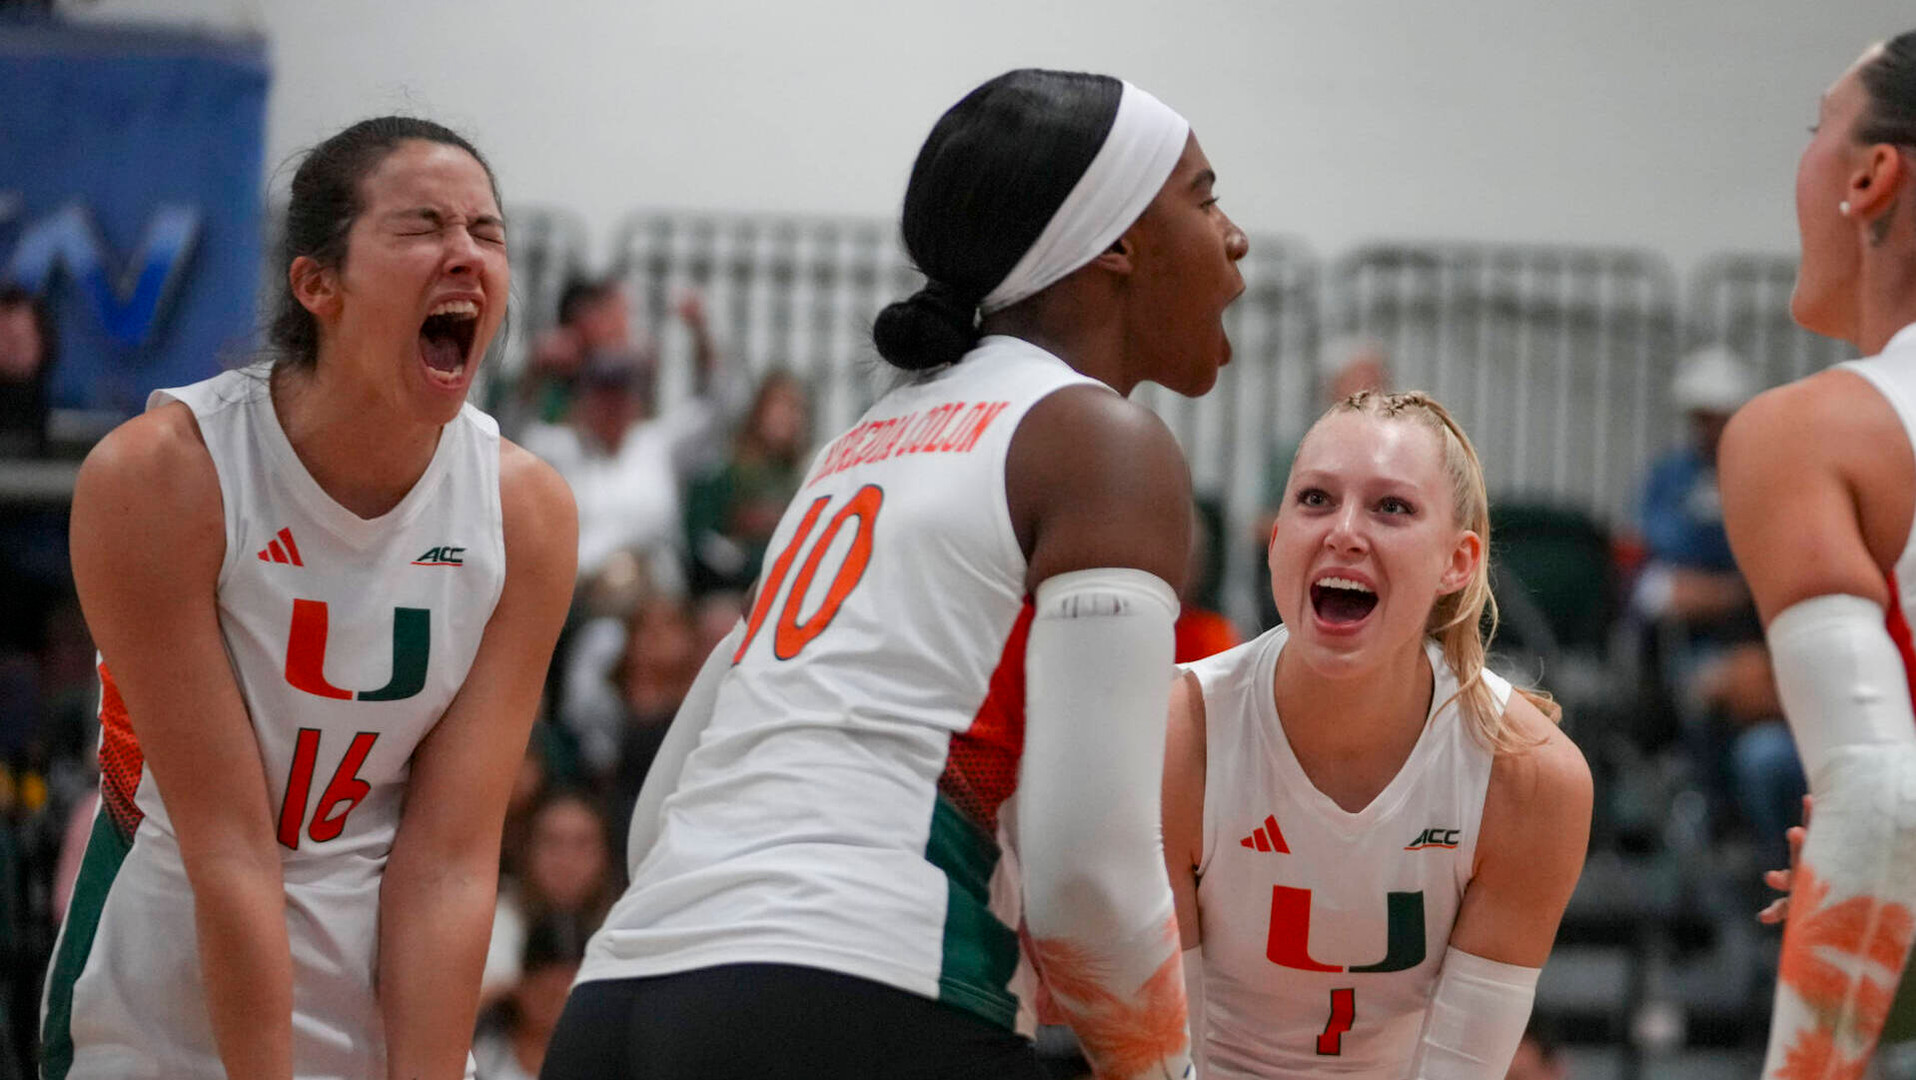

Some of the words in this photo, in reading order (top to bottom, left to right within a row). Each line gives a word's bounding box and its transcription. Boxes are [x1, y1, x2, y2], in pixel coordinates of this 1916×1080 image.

[413, 546, 467, 565] ACC
[731, 484, 884, 663] 10
[285, 598, 431, 702] U
[277, 728, 380, 850] 16
[1407, 828, 1461, 848] ACC
[1266, 884, 1426, 974] U
[1315, 987, 1356, 1057] 1
